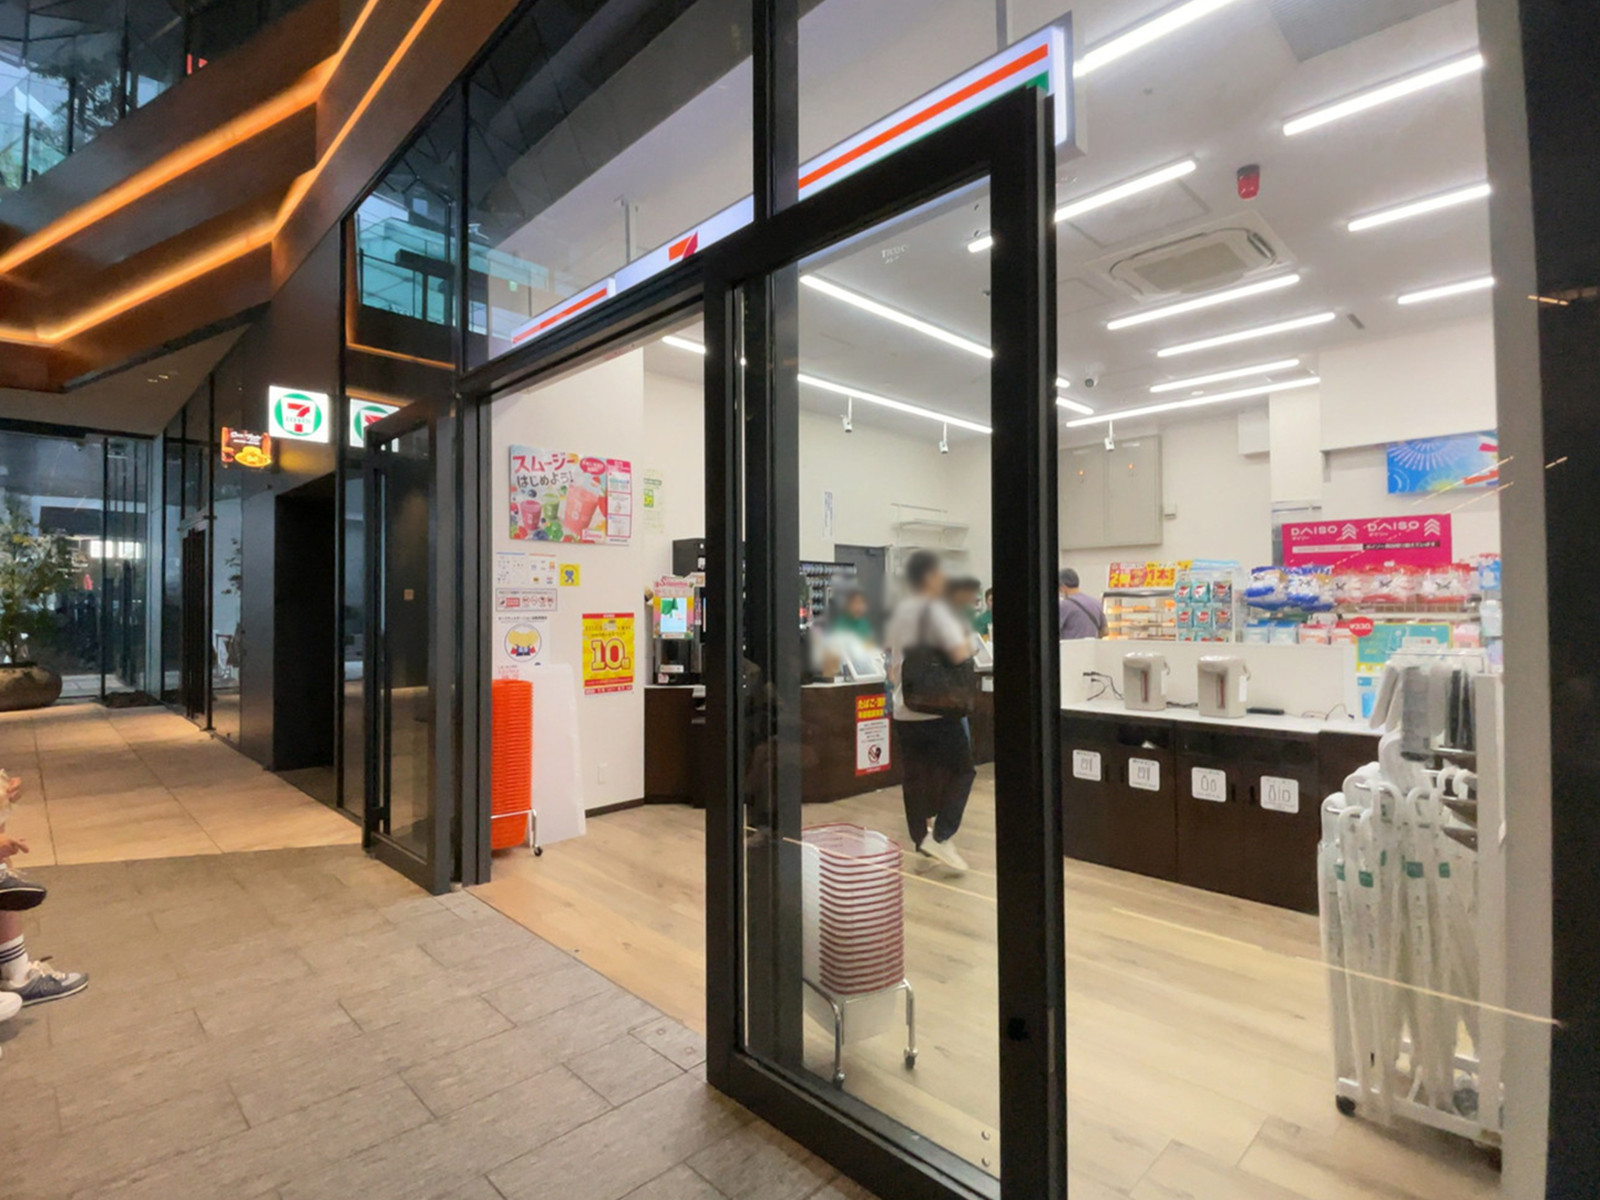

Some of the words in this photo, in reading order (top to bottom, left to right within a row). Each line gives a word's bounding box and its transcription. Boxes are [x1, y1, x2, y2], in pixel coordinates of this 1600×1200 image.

[512, 452, 577, 473] スムージー
[1291, 525, 1338, 536] DAISO
[1367, 521, 1419, 533] DAISO
